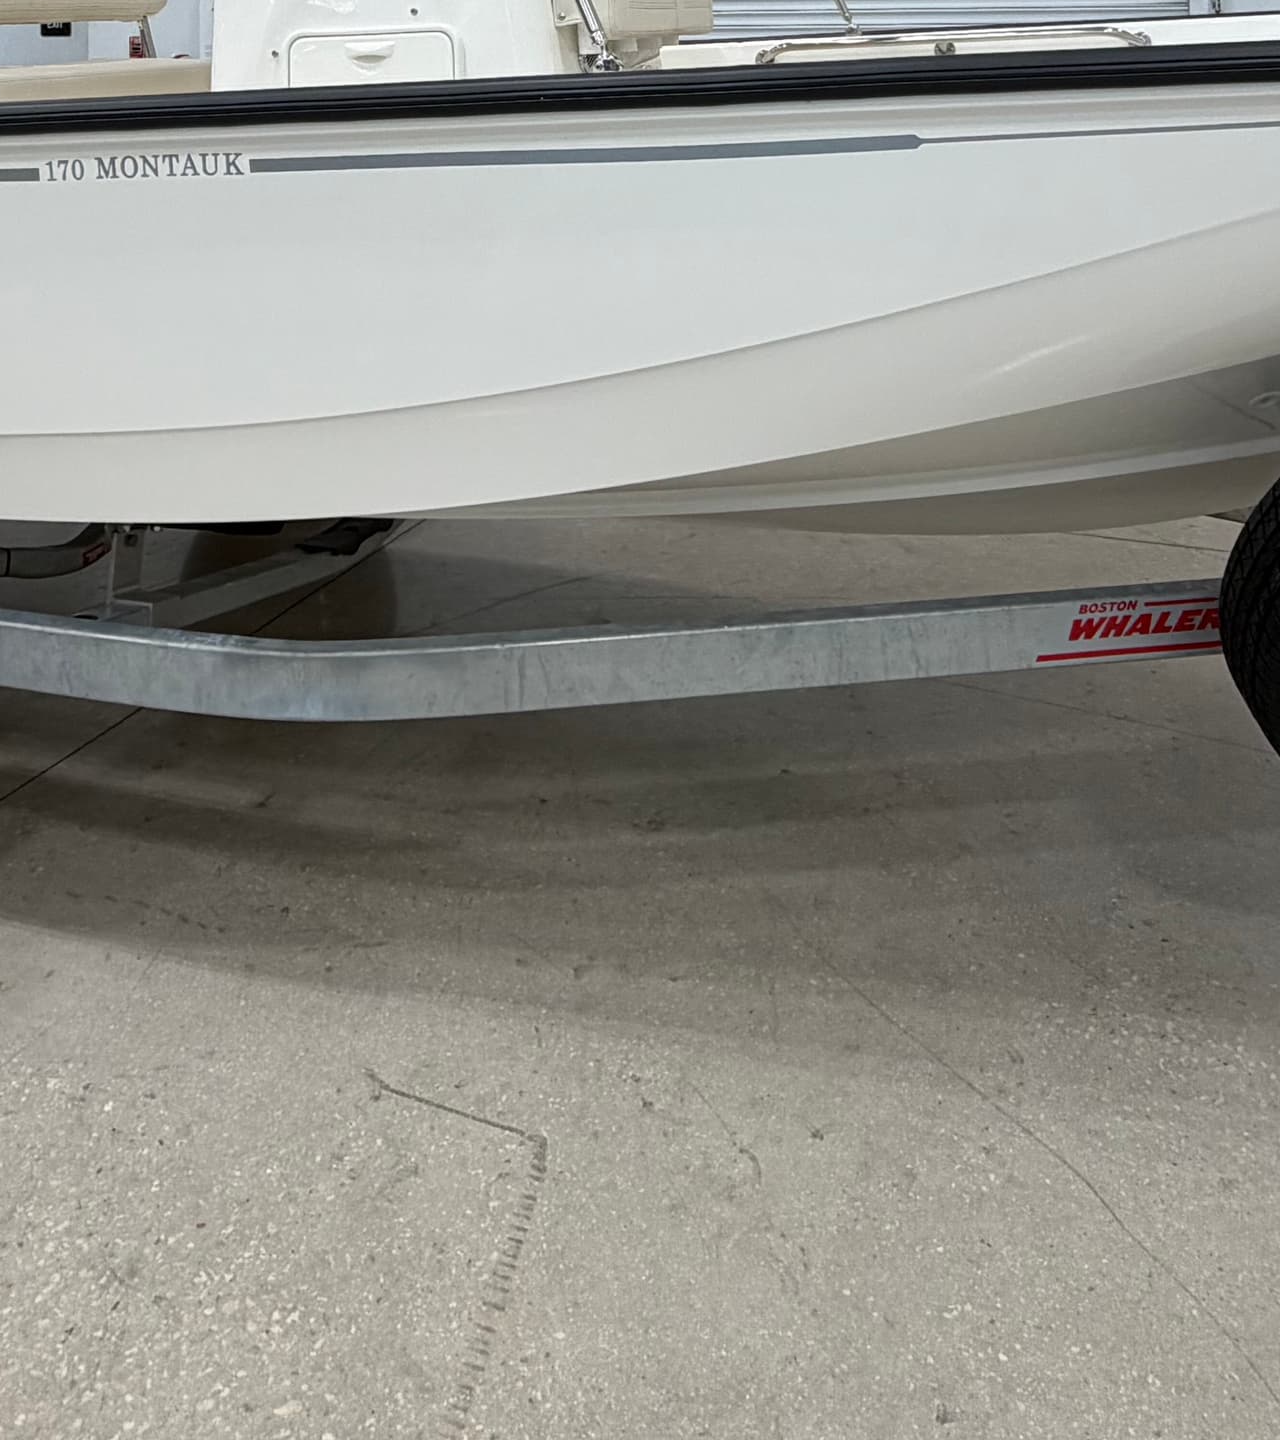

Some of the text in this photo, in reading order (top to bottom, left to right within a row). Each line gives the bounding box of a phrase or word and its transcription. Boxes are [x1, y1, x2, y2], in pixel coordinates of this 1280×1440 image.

[45, 153, 244, 181] 170 MONTAUK
[1078, 600, 1138, 614] BOSTON
[1068, 608, 1221, 641] WHALER
